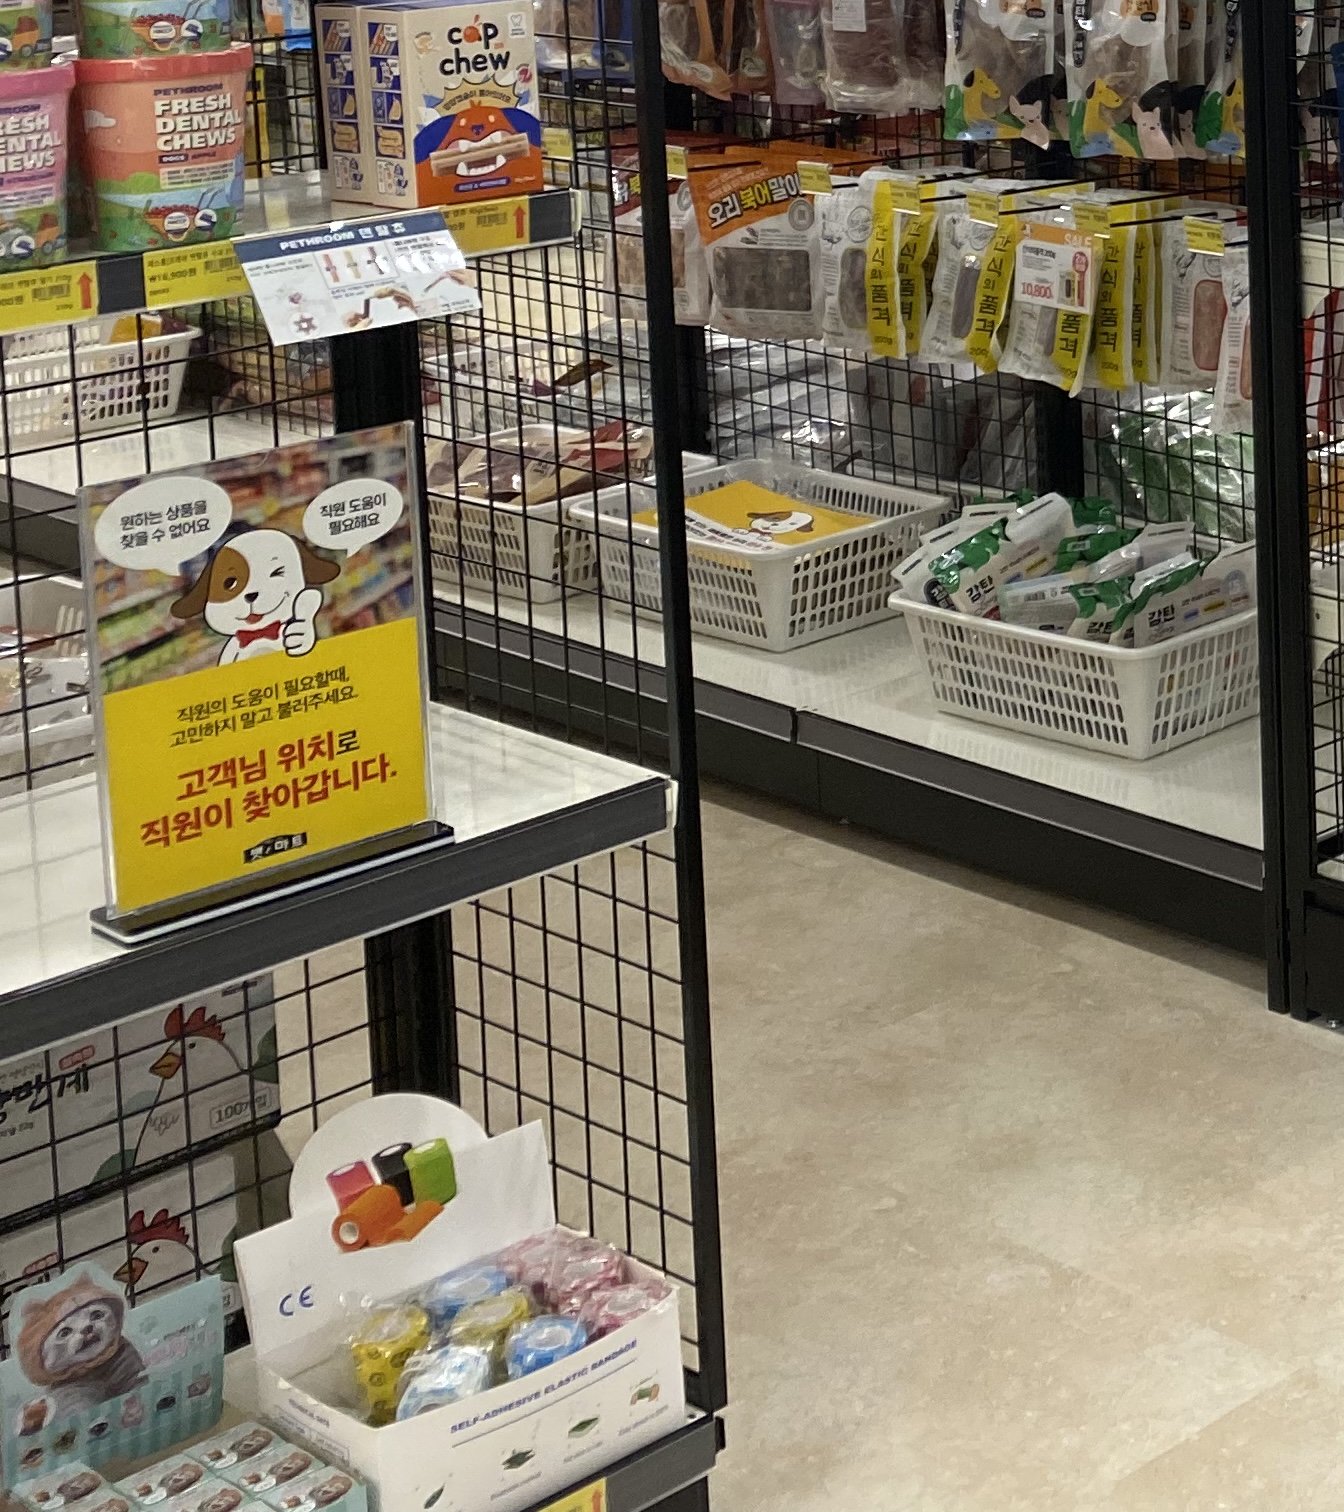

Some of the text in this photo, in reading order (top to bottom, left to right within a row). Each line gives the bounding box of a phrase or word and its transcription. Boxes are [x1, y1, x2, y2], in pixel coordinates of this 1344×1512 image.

[439, 47, 511, 76] chew
[153, 82, 223, 97] PETHROOM
[154, 92, 232, 117] FRESH
[156, 109, 242, 134] DENTAL
[157, 129, 236, 153] CHEWS
[707, 194, 743, 229] 오리
[279, 231, 355, 252] PETHROOM
[1064, 233, 1092, 248] SALE
[974, 233, 1012, 338] 간식의 품격
[871, 284, 891, 326] 품격
[1058, 312, 1082, 359] 품격
[1099, 305, 1118, 353] 품격
[119, 499, 208, 532] 원하는 상품을
[319, 492, 388, 519] 직원 도움이
[119, 517, 212, 550] 찾을 수 없어요
[327, 512, 381, 536] 필요해요
[176, 665, 350, 722] 직원의 도움이 필요할때,
[169, 685, 359, 749] 고민하지 말고 불러주세요.
[176, 728, 361, 802] 고객님 위치로
[139, 751, 398, 849] 직원이 찾아갑니다.
[450, 1337, 638, 1434] SELF-ADHESIVE ELASTIC BANDAGE
